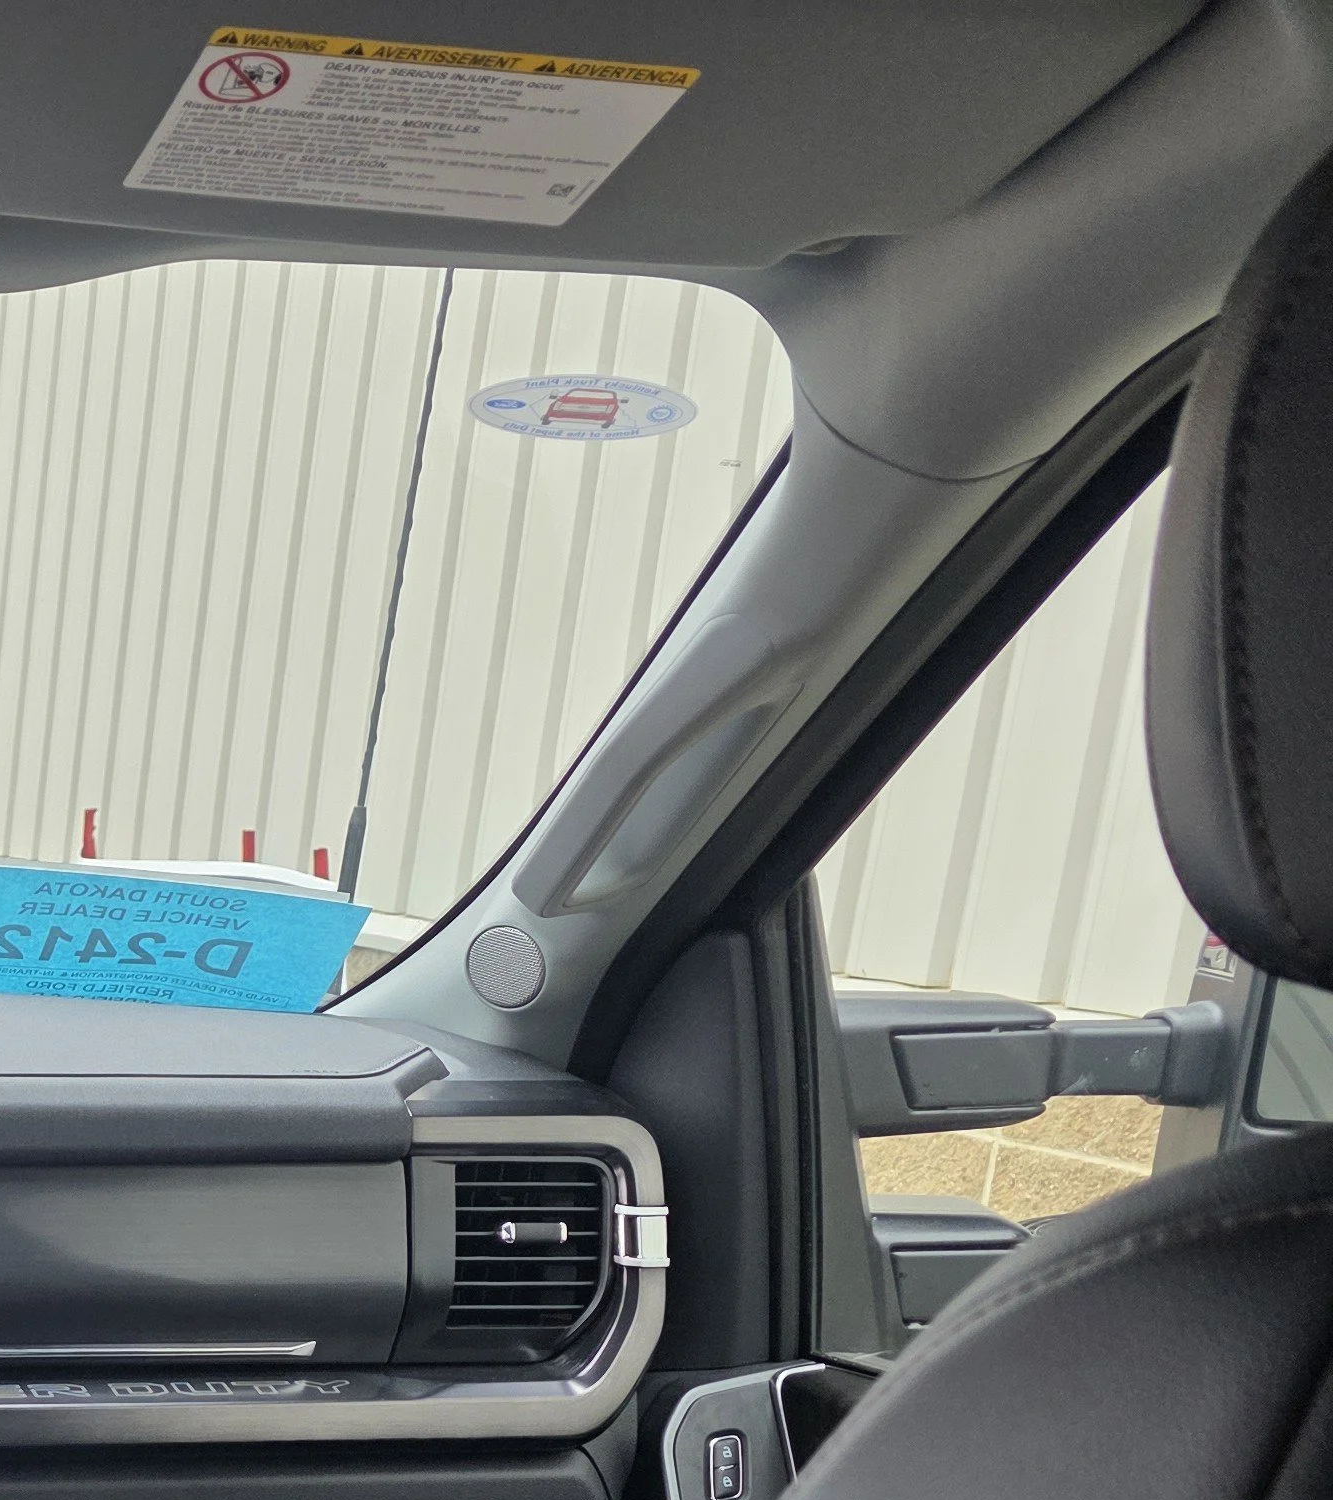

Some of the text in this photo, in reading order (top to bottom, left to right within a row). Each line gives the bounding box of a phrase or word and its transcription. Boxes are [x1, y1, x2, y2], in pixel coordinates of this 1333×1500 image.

[242, 33, 328, 52] WARNING
[372, 45, 523, 69] AVERTISSEMENT
[324, 61, 370, 74] DEATH
[389, 67, 448, 80] SERIOUS
[450, 72, 498, 86] INJURY
[500, 77, 528, 88] can
[530, 80, 565, 91] occur.
[562, 63, 689, 85] ADVERTENCIA
[184, 100, 225, 113] Risque
[228, 103, 243, 112] de
[246, 105, 324, 120] BLESSURES
[331, 113, 379, 125] GRAVES
[401, 119, 481, 134] MORTELLES.
[106, 1380, 350, 1397] DUTY
